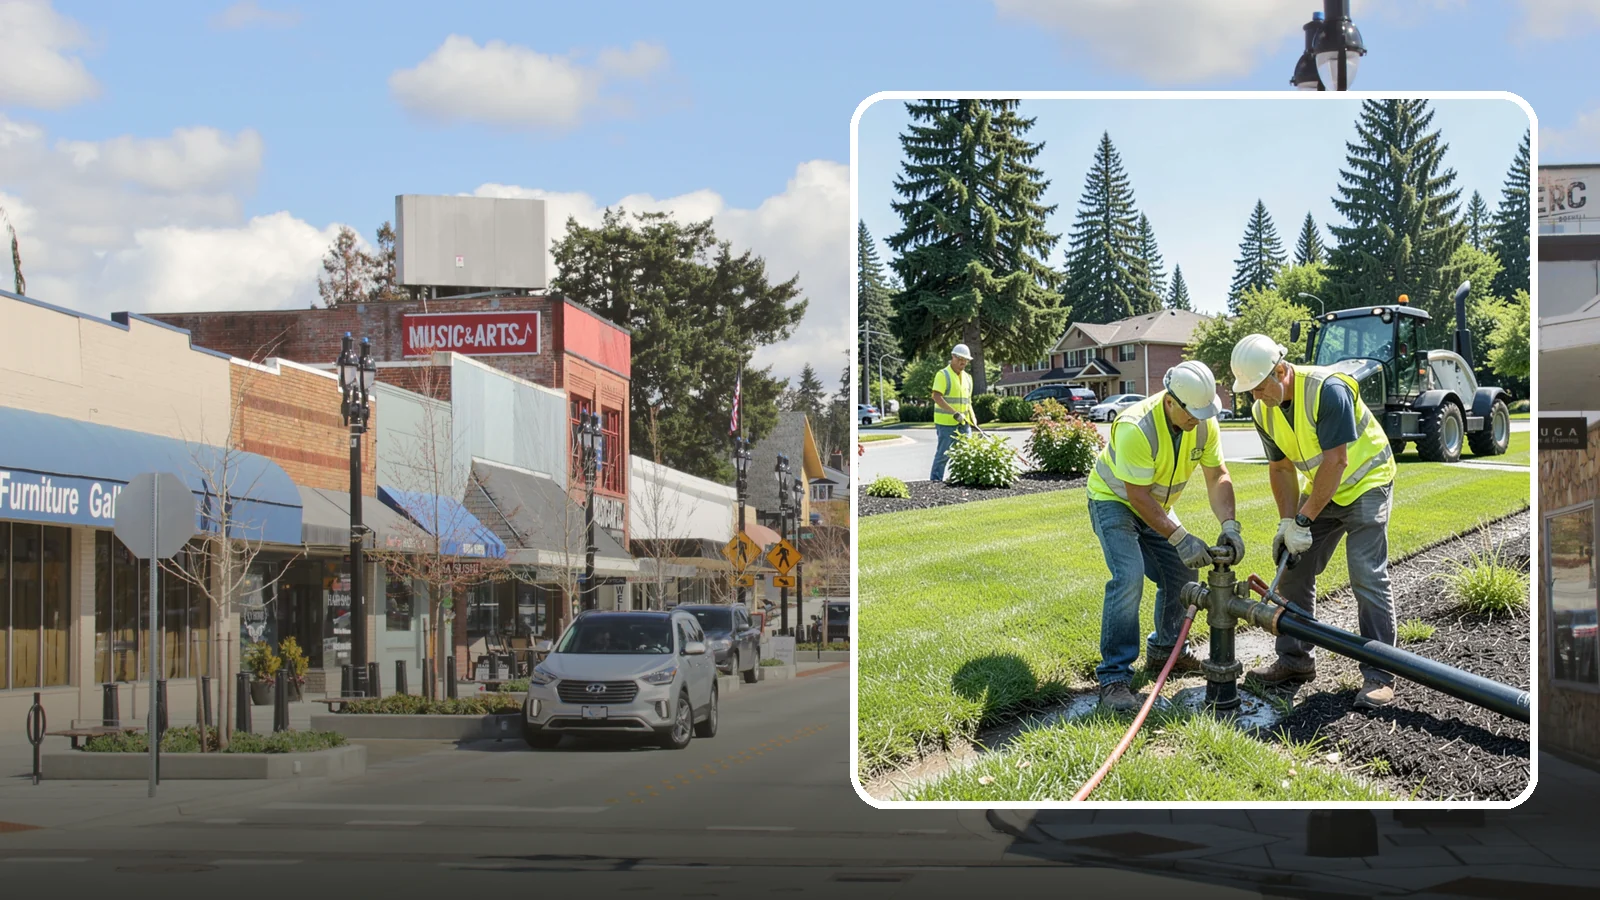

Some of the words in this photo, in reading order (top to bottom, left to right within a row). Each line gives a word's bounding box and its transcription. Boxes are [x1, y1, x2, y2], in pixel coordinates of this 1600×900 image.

[409, 323, 520, 348] MUSIC&ARTS
[0, 471, 79, 515] Furniture
[89, 482, 122, 519] Gal
[453, 563, 479, 574] SUSHI
